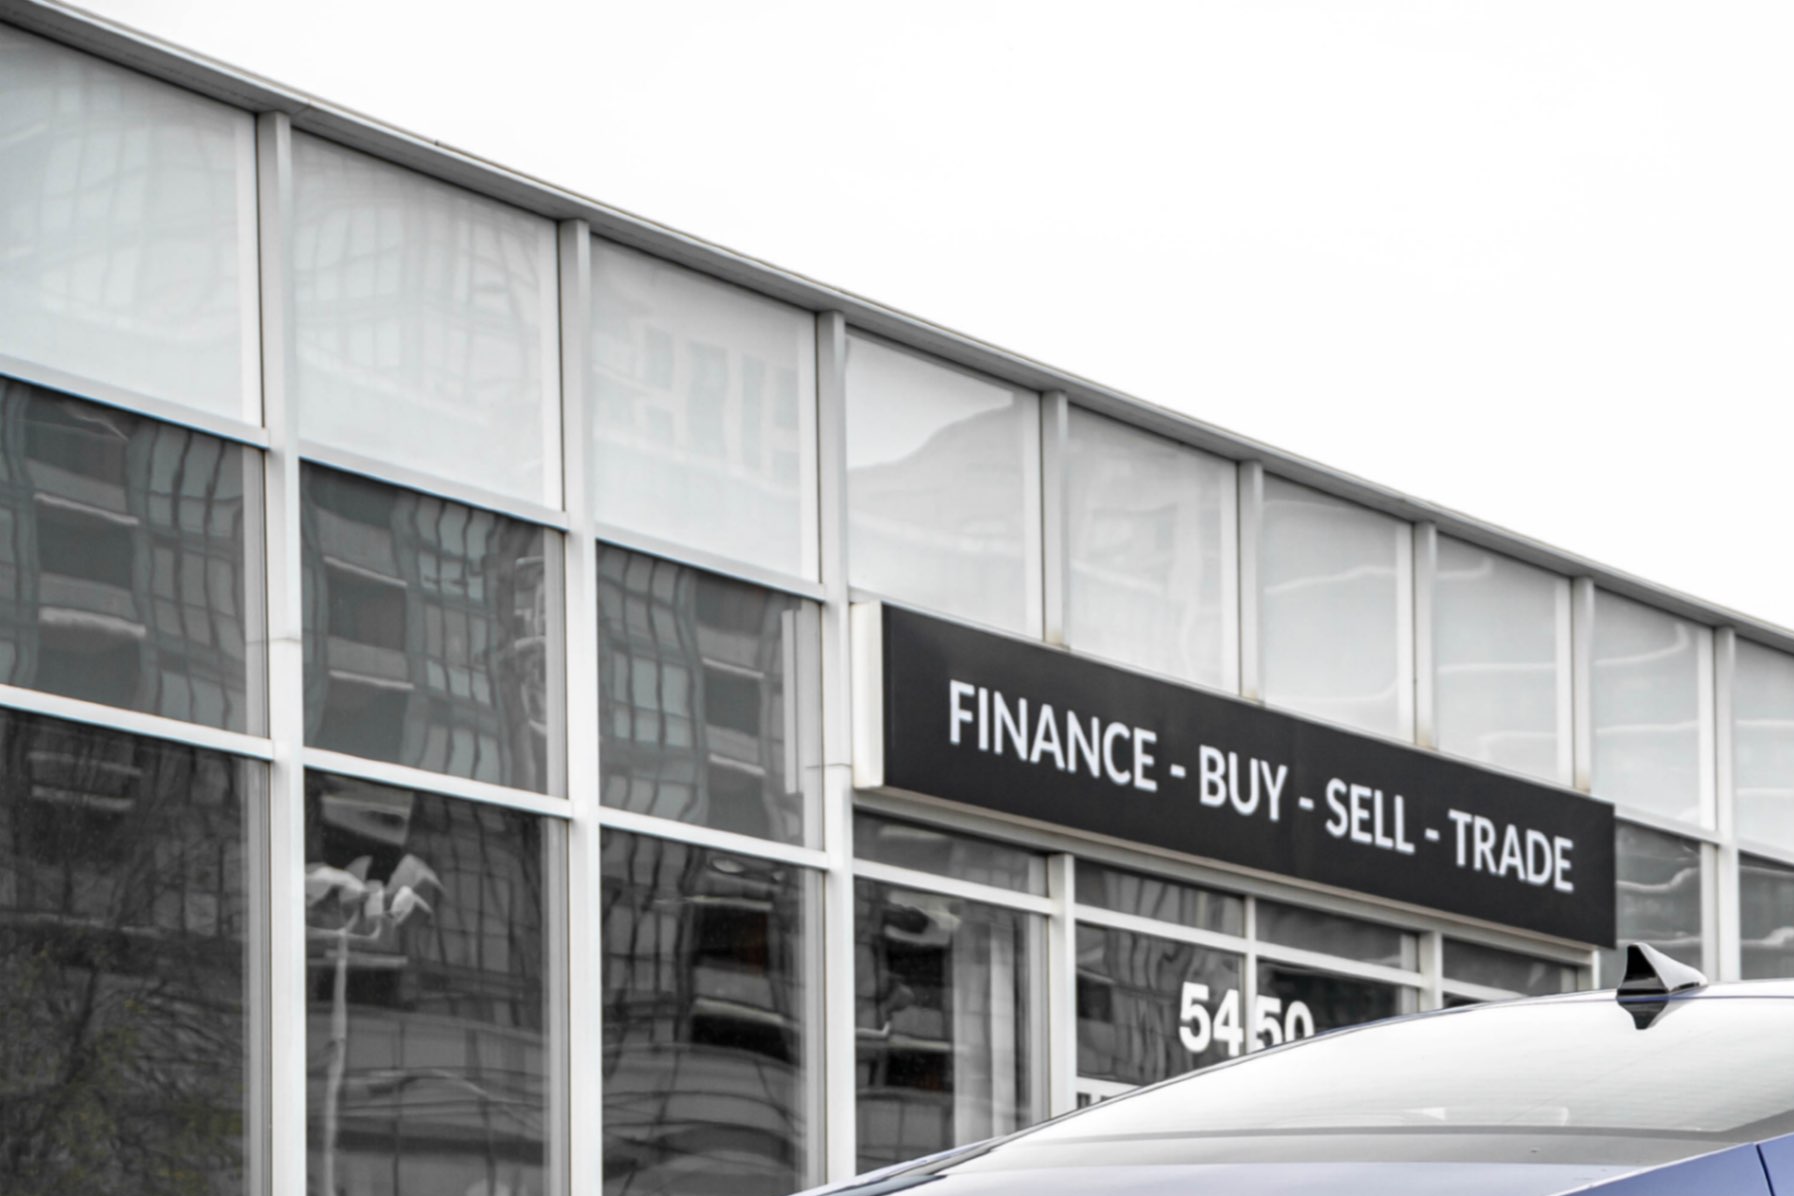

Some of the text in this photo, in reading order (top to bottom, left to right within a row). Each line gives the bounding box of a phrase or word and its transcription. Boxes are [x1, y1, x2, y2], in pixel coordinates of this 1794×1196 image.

[949, 679, 1159, 792] FINANCE
[1199, 744, 1288, 821] BUY
[1325, 777, 1415, 854] SELL
[1448, 809, 1574, 892] TRADE
